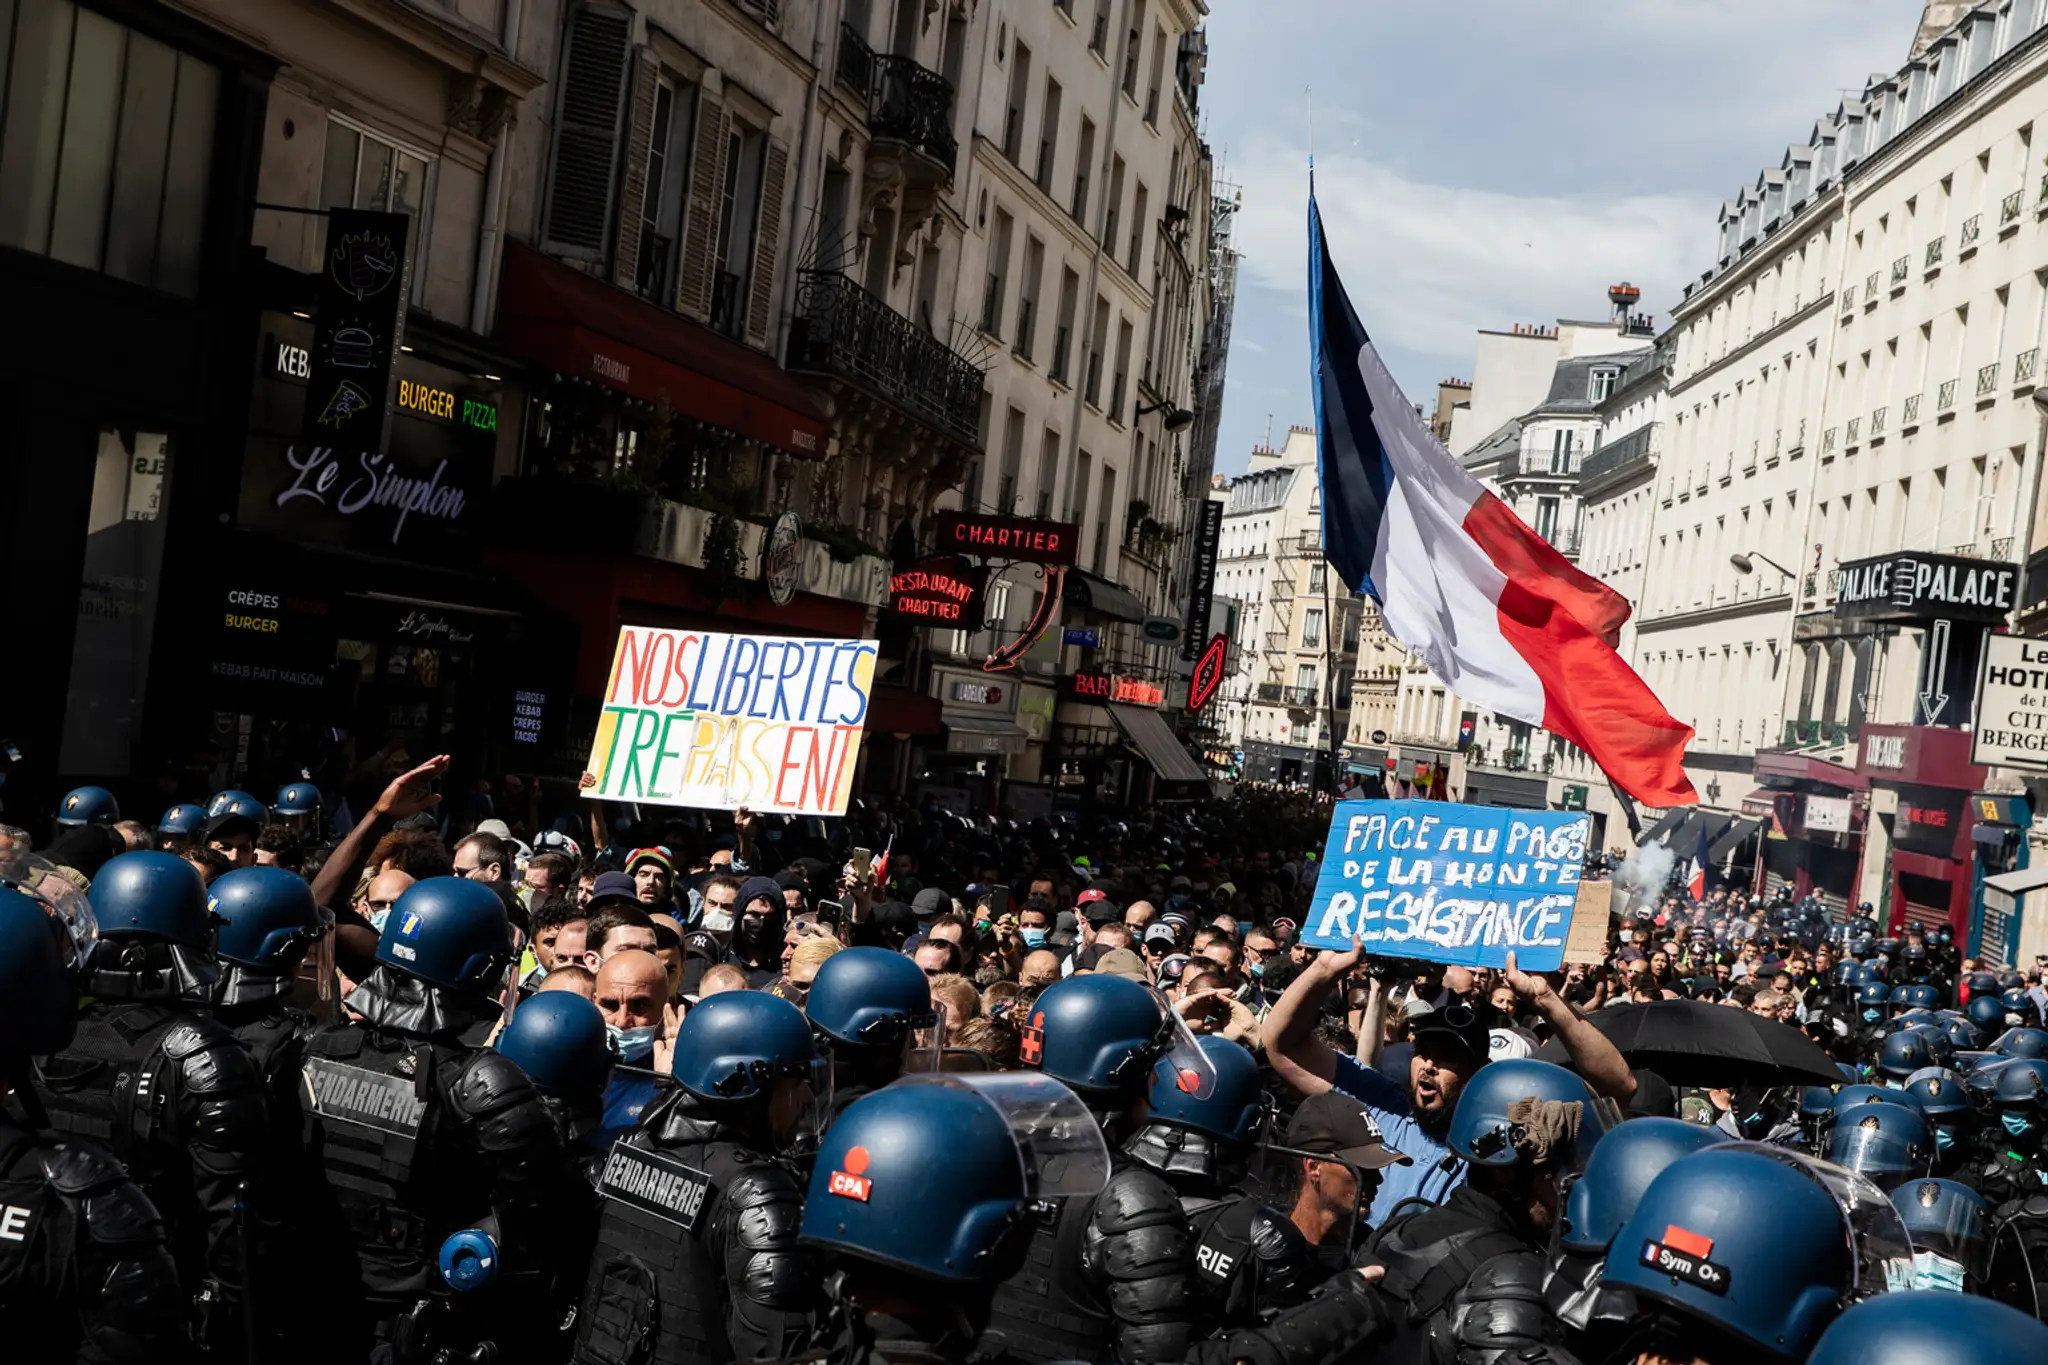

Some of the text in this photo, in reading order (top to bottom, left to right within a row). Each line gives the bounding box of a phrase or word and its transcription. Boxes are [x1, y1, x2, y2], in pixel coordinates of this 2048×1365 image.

[399, 380, 455, 420] BURGER
[462, 399, 497, 431] PIZZA
[277, 445, 466, 545] Le Simplon
[954, 523, 1060, 552] CHARTIER
[228, 588, 280, 610] CRÊPES
[889, 571, 975, 604] RESTAURANT
[1836, 562, 1892, 604] PALACE
[1915, 563, 2013, 608] PALACE
[224, 613, 279, 634] BURGER
[898, 596, 960, 620] CHARTIER
[212, 661, 324, 688] KEBAB FAIT MAISON
[609, 630, 877, 725] NOS LIBERTÉS
[1074, 674, 1109, 697] BAR
[515, 703, 542, 717] KEBAB
[2020, 693, 2036, 707] de
[513, 729, 539, 744] TACOS
[1343, 814, 1440, 855] FACE
[1439, 826, 1499, 855] AU
[1343, 855, 1582, 889] DE LA HONTE
[312, 1070, 422, 1128] ENDARMERIE
[603, 1152, 707, 1217] GENDARMERIE
[834, 1174, 863, 1196] CPA
[1196, 1243, 1234, 1279] RIE
[1659, 1248, 1720, 1281] Sym O+
